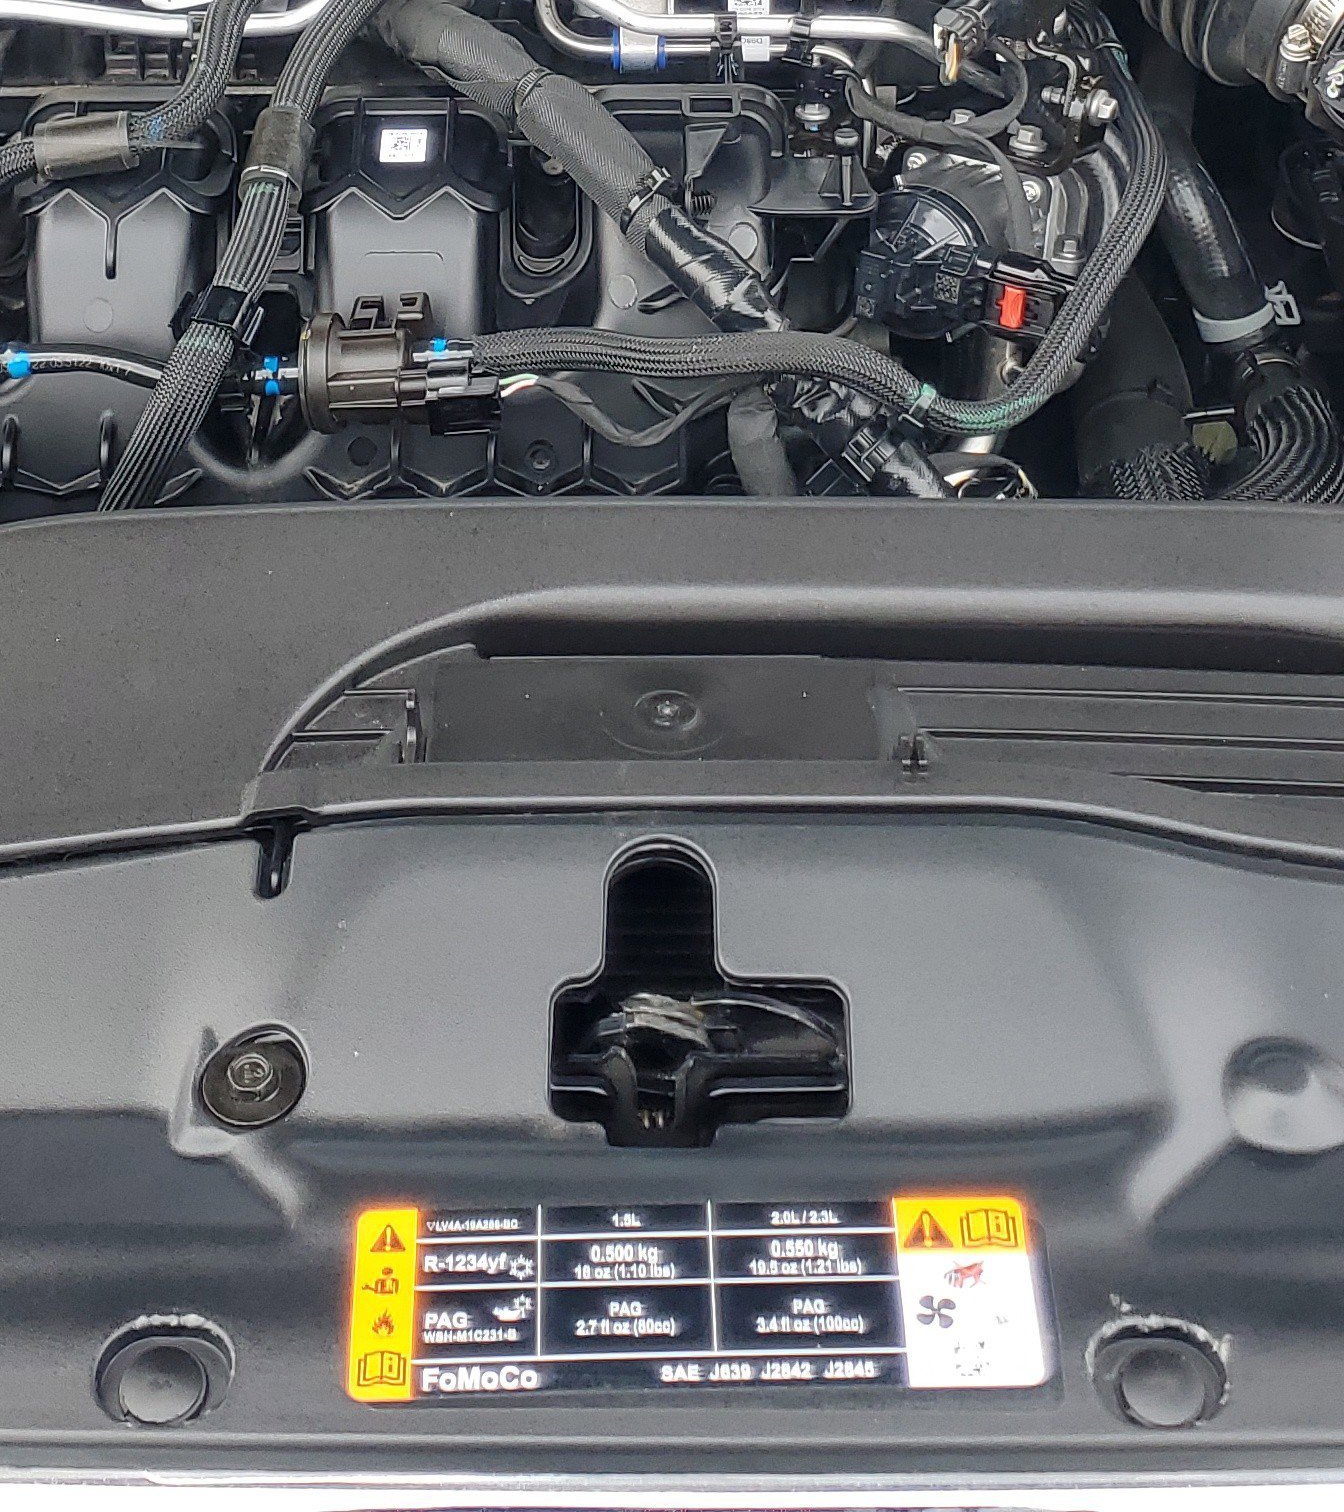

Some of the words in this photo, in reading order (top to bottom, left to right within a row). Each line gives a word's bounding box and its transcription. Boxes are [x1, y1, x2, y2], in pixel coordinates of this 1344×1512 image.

[612, 1213, 642, 1228] 1.5L
[770, 1210, 800, 1225] 2.0L
[809, 1209, 840, 1224] 2.3L
[590, 1244, 634, 1263] 0.500
[638, 1243, 659, 1264] kg
[770, 1239, 813, 1258] 0.550
[817, 1238, 839, 1259] kg
[424, 1253, 508, 1274] R-1234yf
[594, 1268, 611, 1279] oz
[614, 1264, 647, 1280] (1.10
[649, 1263, 676, 1279] lbs)
[749, 1259, 778, 1275] 19.5
[781, 1262, 798, 1274] oz
[801, 1259, 832, 1276] (1.21
[836, 1258, 862, 1275] lbs)
[609, 1301, 643, 1317] PAG
[792, 1298, 826, 1314] PAG
[424, 1311, 469, 1329] PAG
[575, 1319, 598, 1336] 2.7
[600, 1318, 610, 1335] fl
[612, 1322, 631, 1335] oz
[633, 1317, 676, 1337] (80cc)
[756, 1316, 778, 1333] 3.4
[780, 1316, 790, 1333] fl
[793, 1320, 811, 1332] oz
[813, 1314, 864, 1335] (100cc)
[421, 1365, 538, 1393] FoMoCo
[660, 1364, 701, 1382] SAE
[710, 1362, 752, 1381] J639
[760, 1361, 813, 1380] J2842
[823, 1360, 876, 1379] J2845
